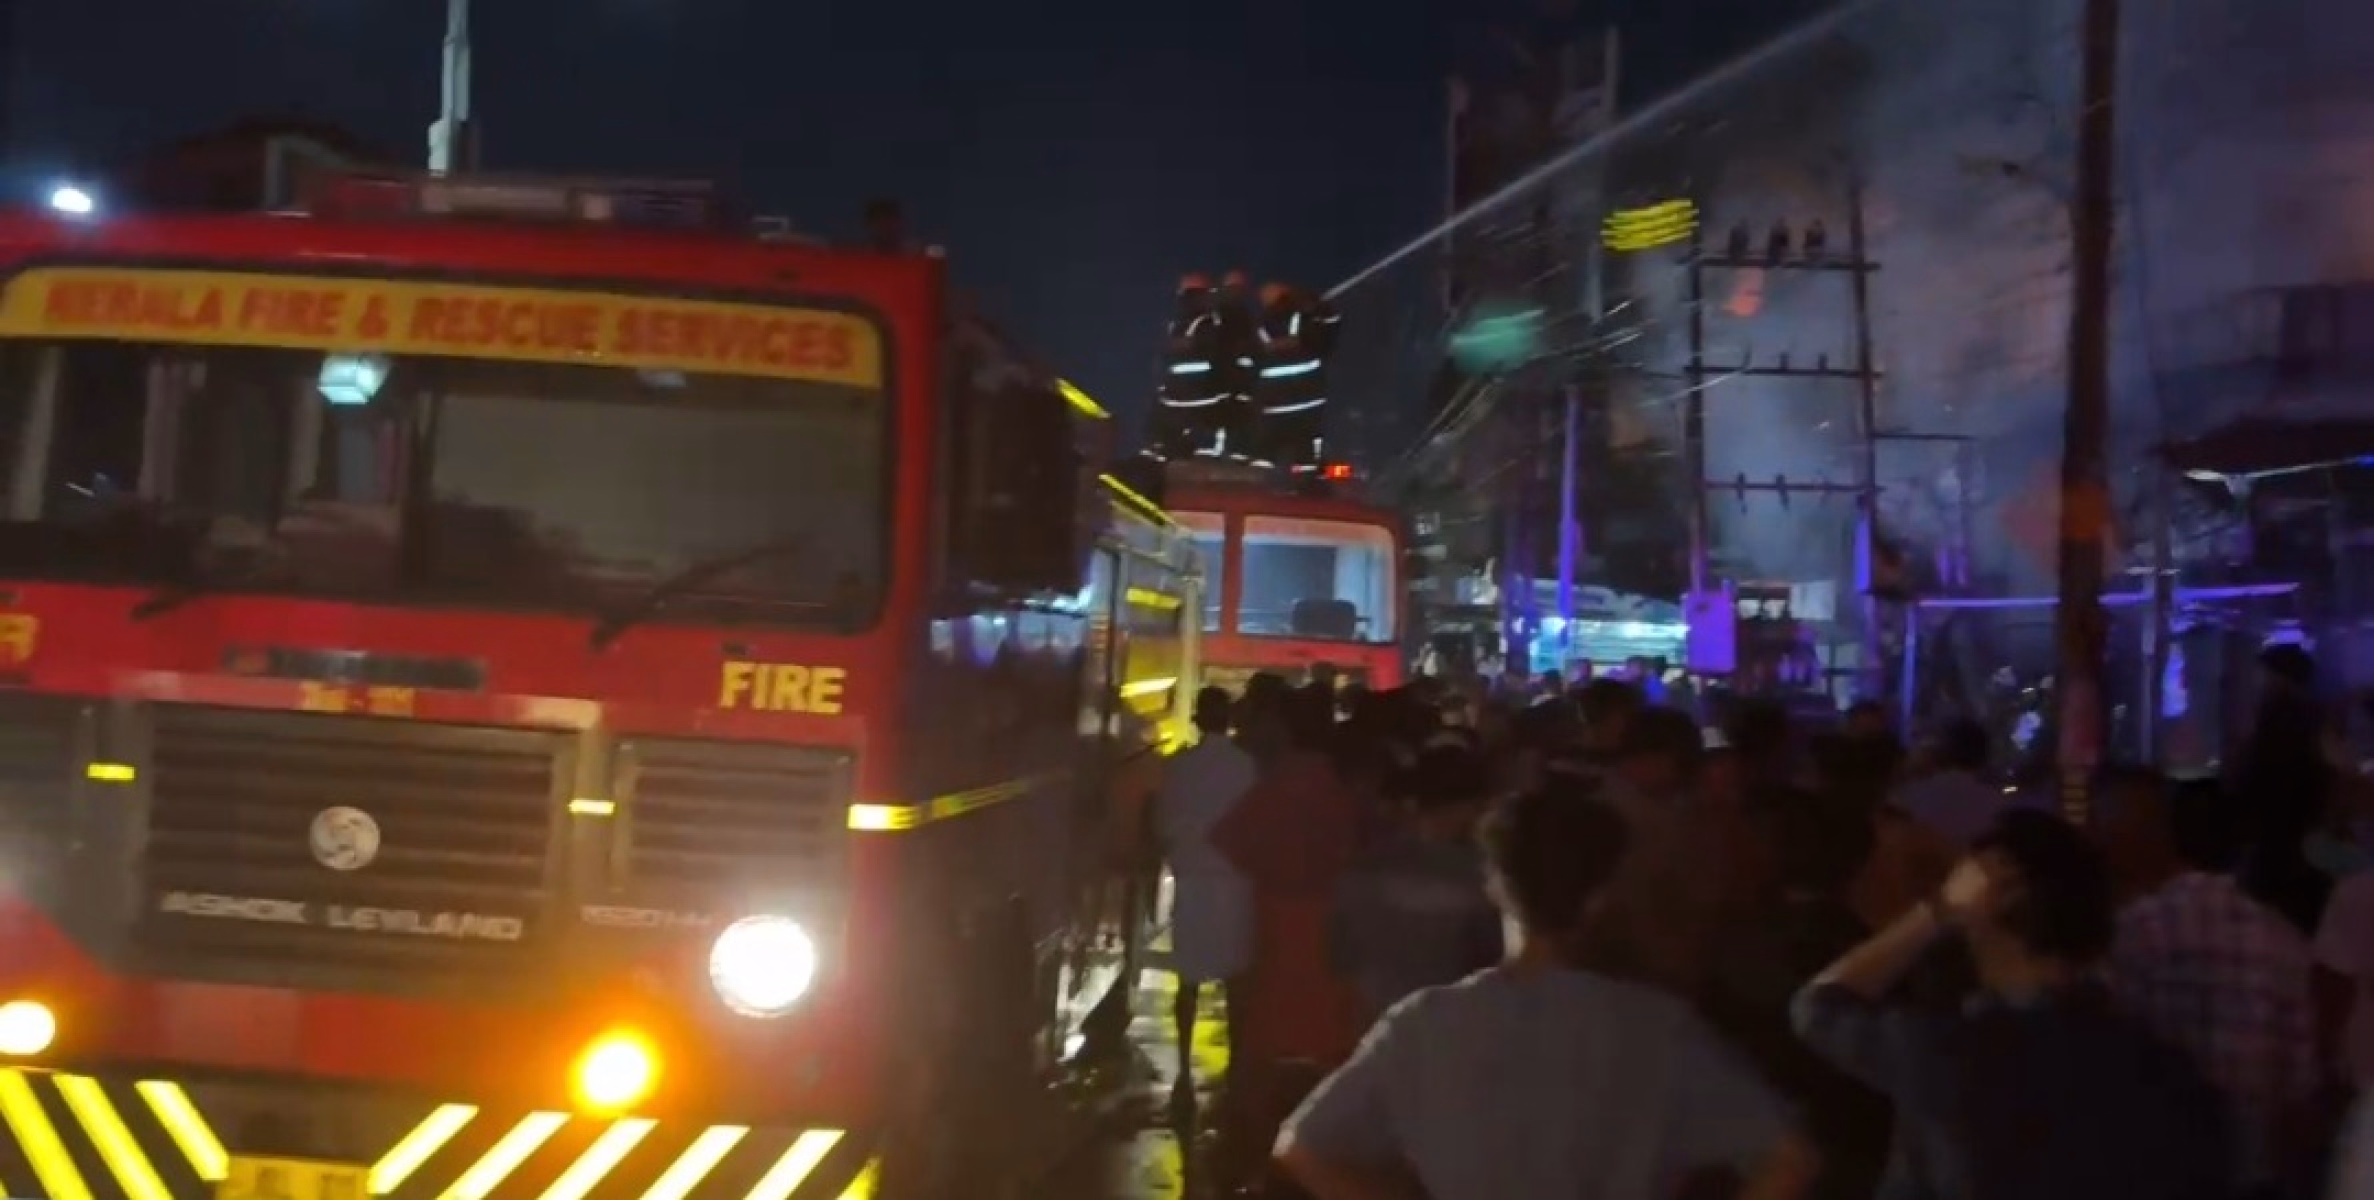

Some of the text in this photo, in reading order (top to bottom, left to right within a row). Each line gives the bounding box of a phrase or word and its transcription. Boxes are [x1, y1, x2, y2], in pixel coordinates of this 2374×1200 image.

[239, 288, 347, 335] FIRE
[357, 294, 388, 338] &
[410, 297, 603, 351] RESCUE
[617, 305, 856, 373] SERVICES
[720, 661, 846, 714] FIRE
[160, 889, 524, 942] ASHOK LEYLAND
